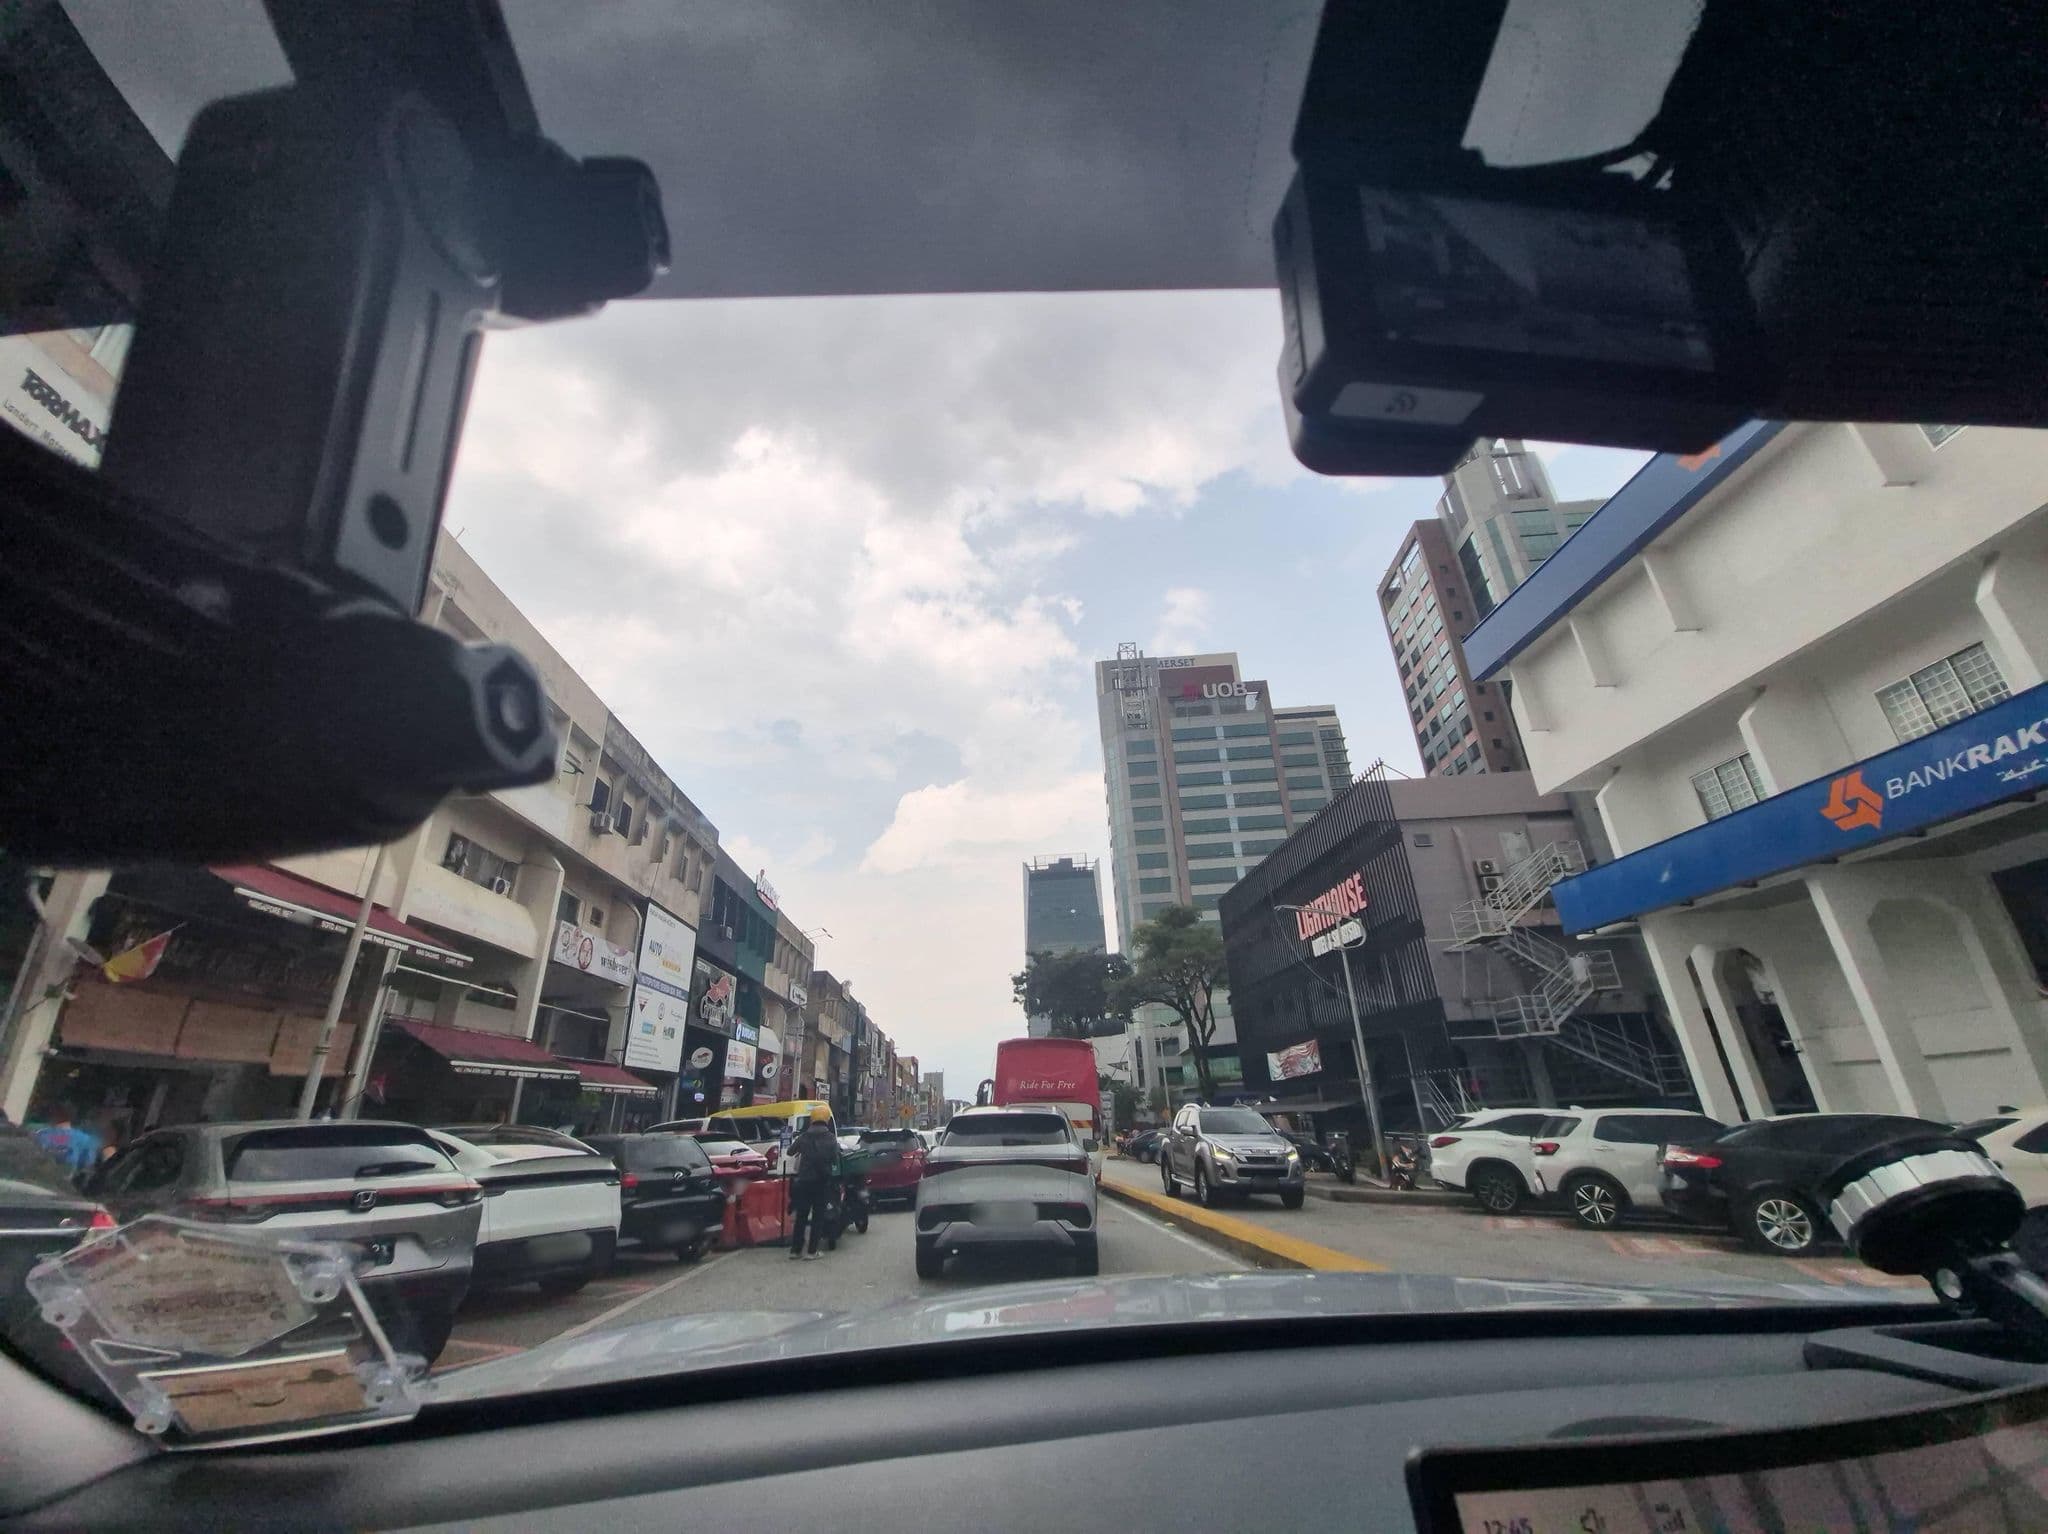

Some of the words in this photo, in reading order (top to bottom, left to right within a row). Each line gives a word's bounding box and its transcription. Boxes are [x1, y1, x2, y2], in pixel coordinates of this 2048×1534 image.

[1203, 681, 1248, 698] UOB
[1296, 871, 1367, 940] LIGHTHOUSE
[1020, 1080, 1039, 1089] Ride
[1041, 1080, 1055, 1089] For
[1057, 1080, 1076, 1089] Free
